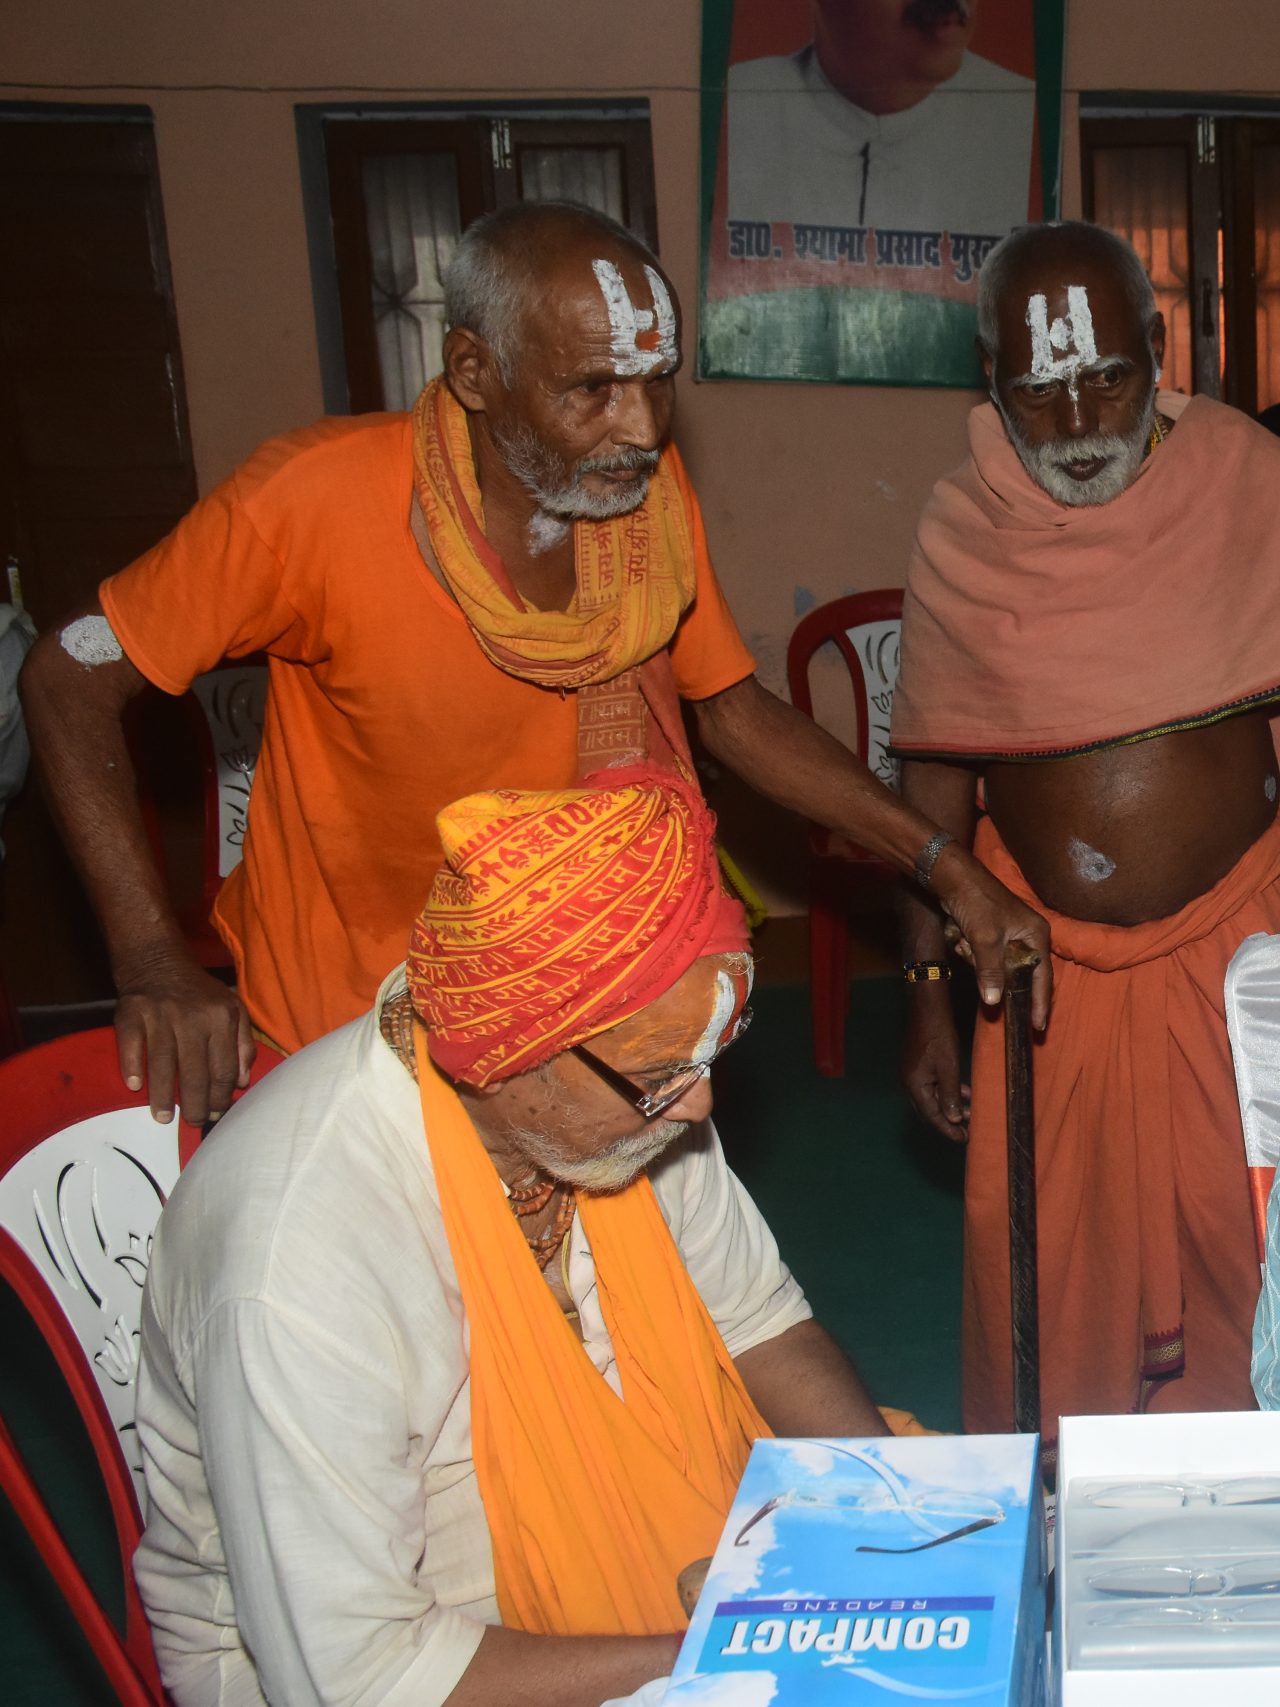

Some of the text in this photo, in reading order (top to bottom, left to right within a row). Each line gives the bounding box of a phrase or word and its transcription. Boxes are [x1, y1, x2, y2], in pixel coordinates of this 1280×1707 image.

[793, 224, 866, 263] श्यामा
[876, 229, 942, 267] प्रसाद
[625, 528, 649, 551] श्री
[628, 552, 648, 586] जय
[506, 920, 568, 953] राम
[581, 860, 640, 902] राम
[489, 974, 553, 1000] राम
[566, 920, 627, 962] राम
[782, 1600, 927, 1612] READING
[720, 1616, 970, 1656] COMPACT
